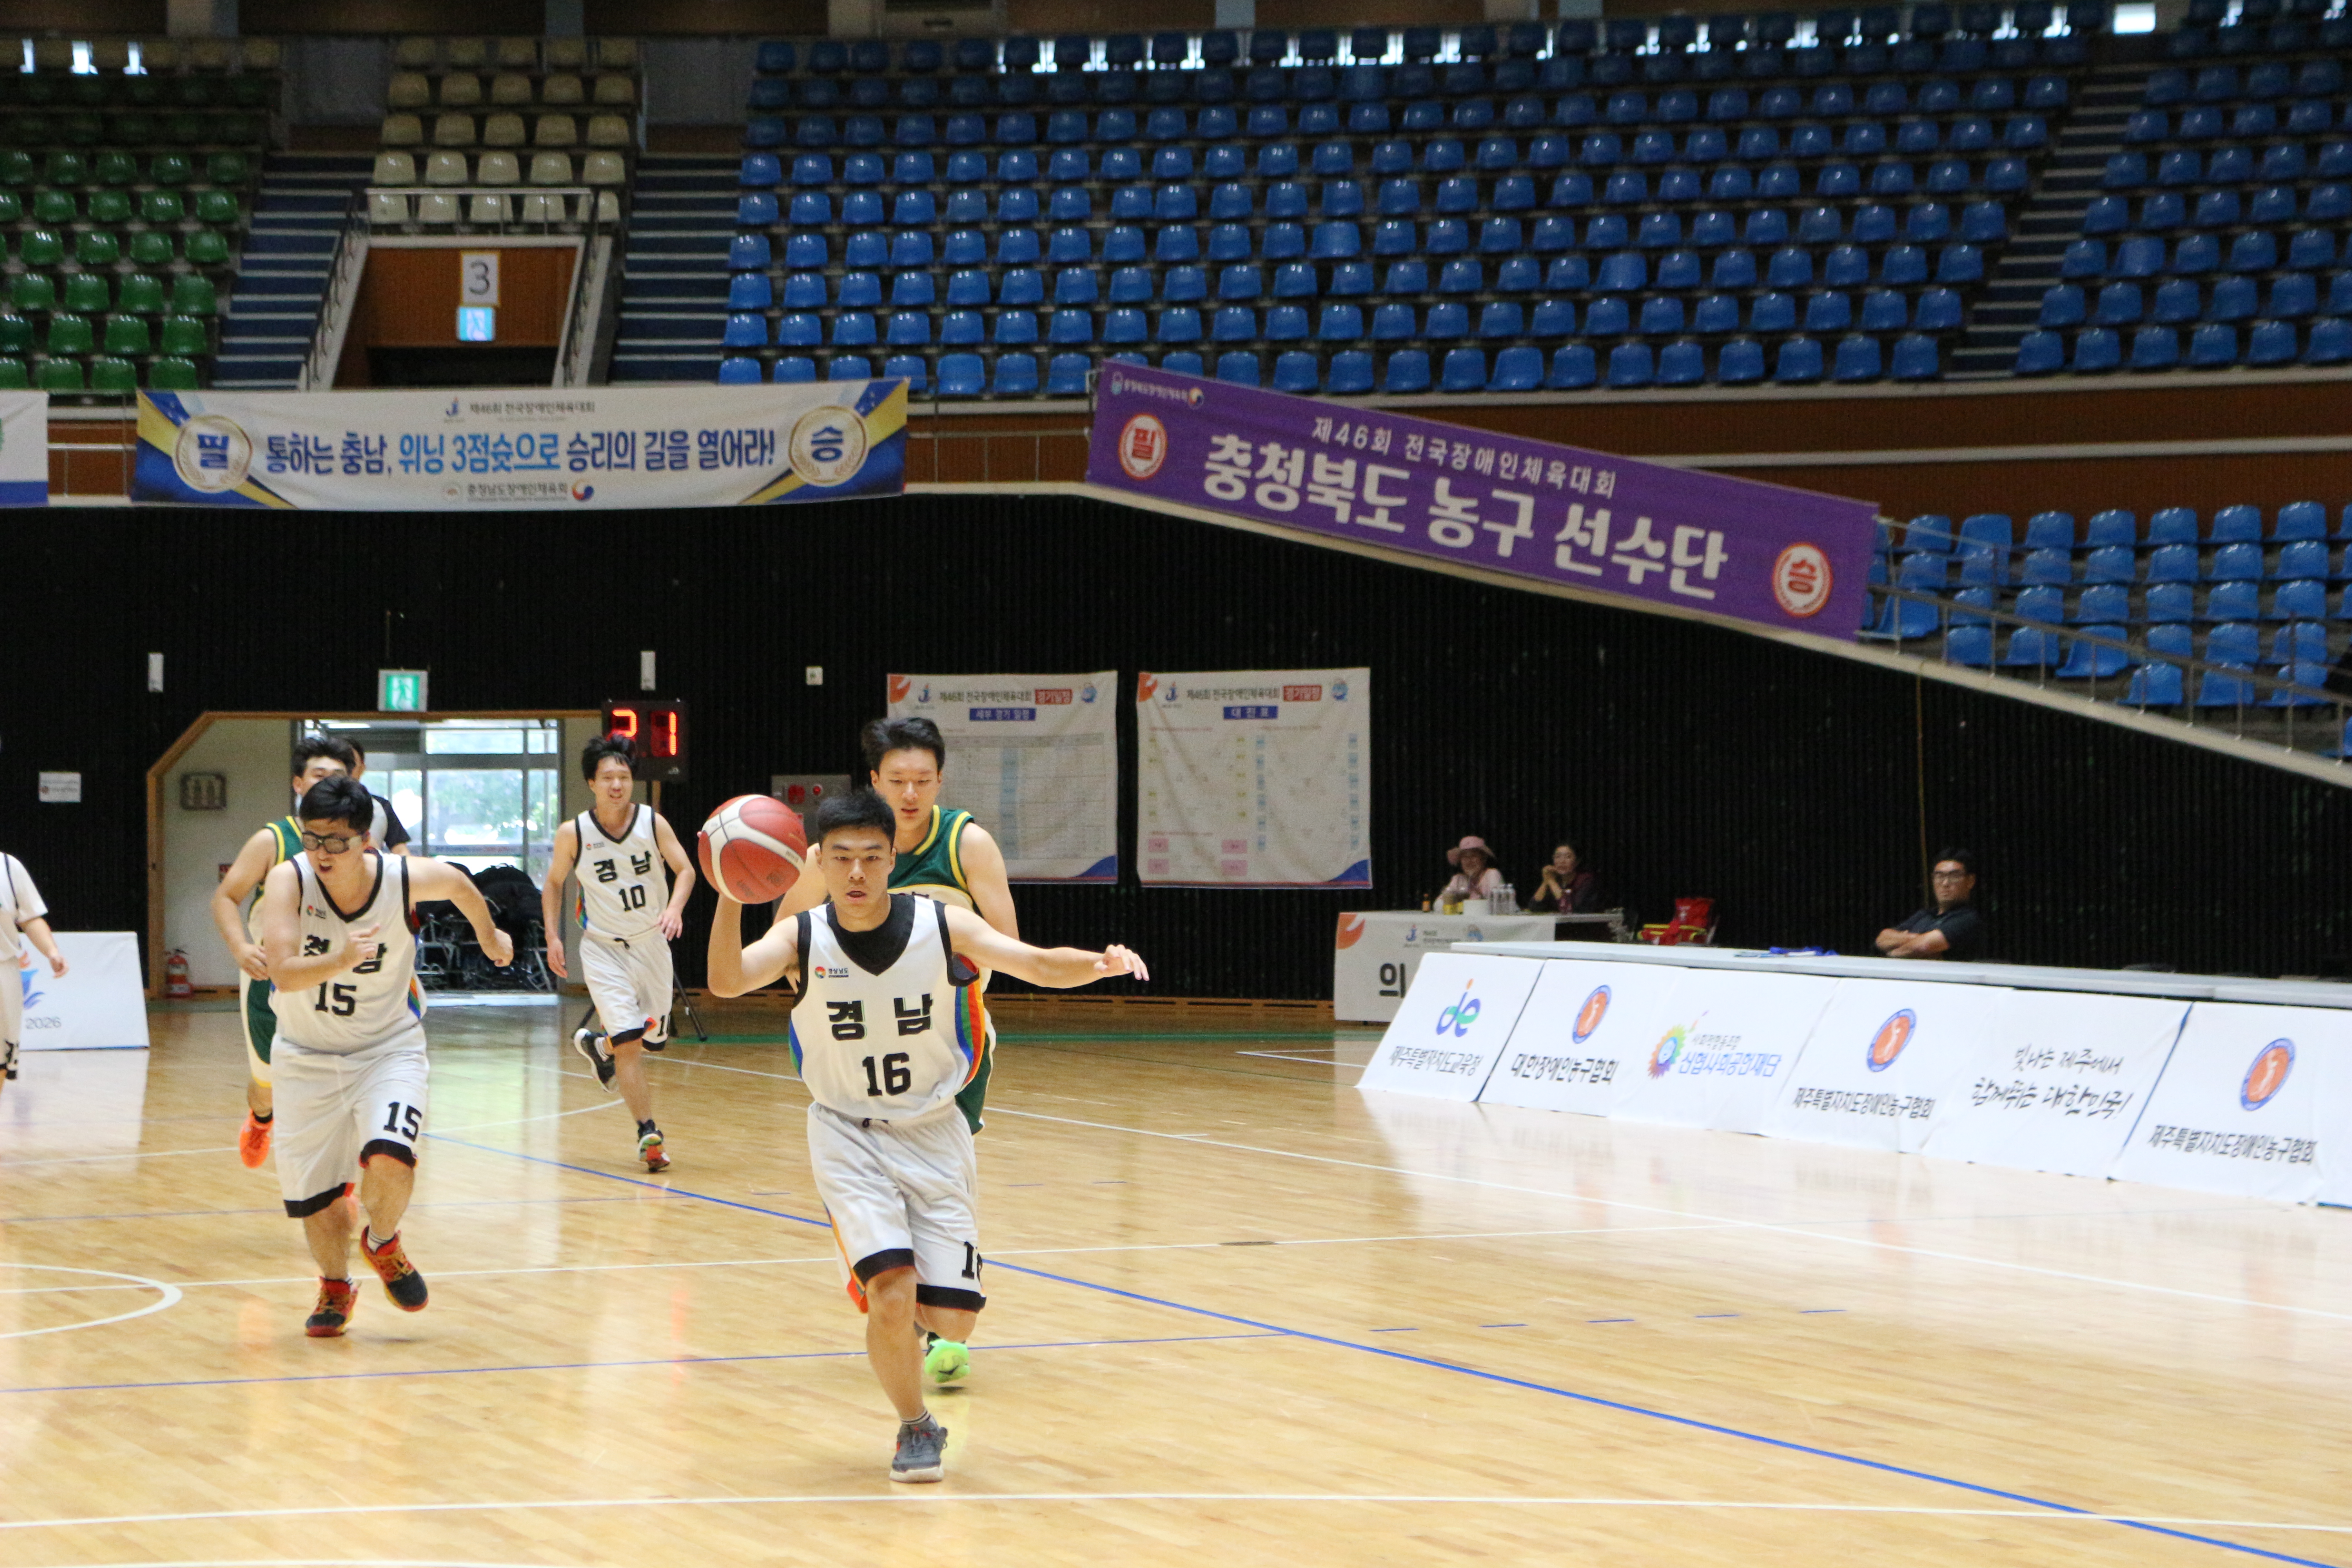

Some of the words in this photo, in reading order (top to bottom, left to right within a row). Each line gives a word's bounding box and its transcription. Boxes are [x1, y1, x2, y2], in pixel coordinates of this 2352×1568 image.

[469, 259, 490, 295] 3
[198, 434, 229, 469] 필
[267, 431, 334, 475] 통하는
[340, 431, 392, 477] 충남,
[399, 434, 444, 474] 위닝
[452, 432, 560, 473] 3점슛으로
[567, 431, 636, 472] 승리의
[643, 430, 690, 471] 길을
[697, 428, 775, 471] 열어라!
[811, 426, 844, 462] 승
[1312, 416, 1392, 455] 제46회
[1405, 433, 1617, 499] 전국장애인체육대회
[1204, 434, 1411, 534] 충청북도
[1428, 476, 1536, 558] 농구
[1555, 503, 1728, 600] 선수단
[606, 709, 676, 755] 21
[618, 884, 646, 912] 10
[315, 981, 357, 1017] 15
[25, 1016, 62, 1029] 2026
[862, 1052, 912, 1097] 16
[1389, 1046, 1484, 1077] 제주특별자치도교육청
[1511, 1053, 1620, 1085] 대한장애인농구협회
[1792, 1087, 1937, 1120] 제주특별자치도장애인농구협회
[383, 1101, 422, 1143] 15
[2147, 1124, 2318, 1165] 제주특별자치도장애인농구협회
